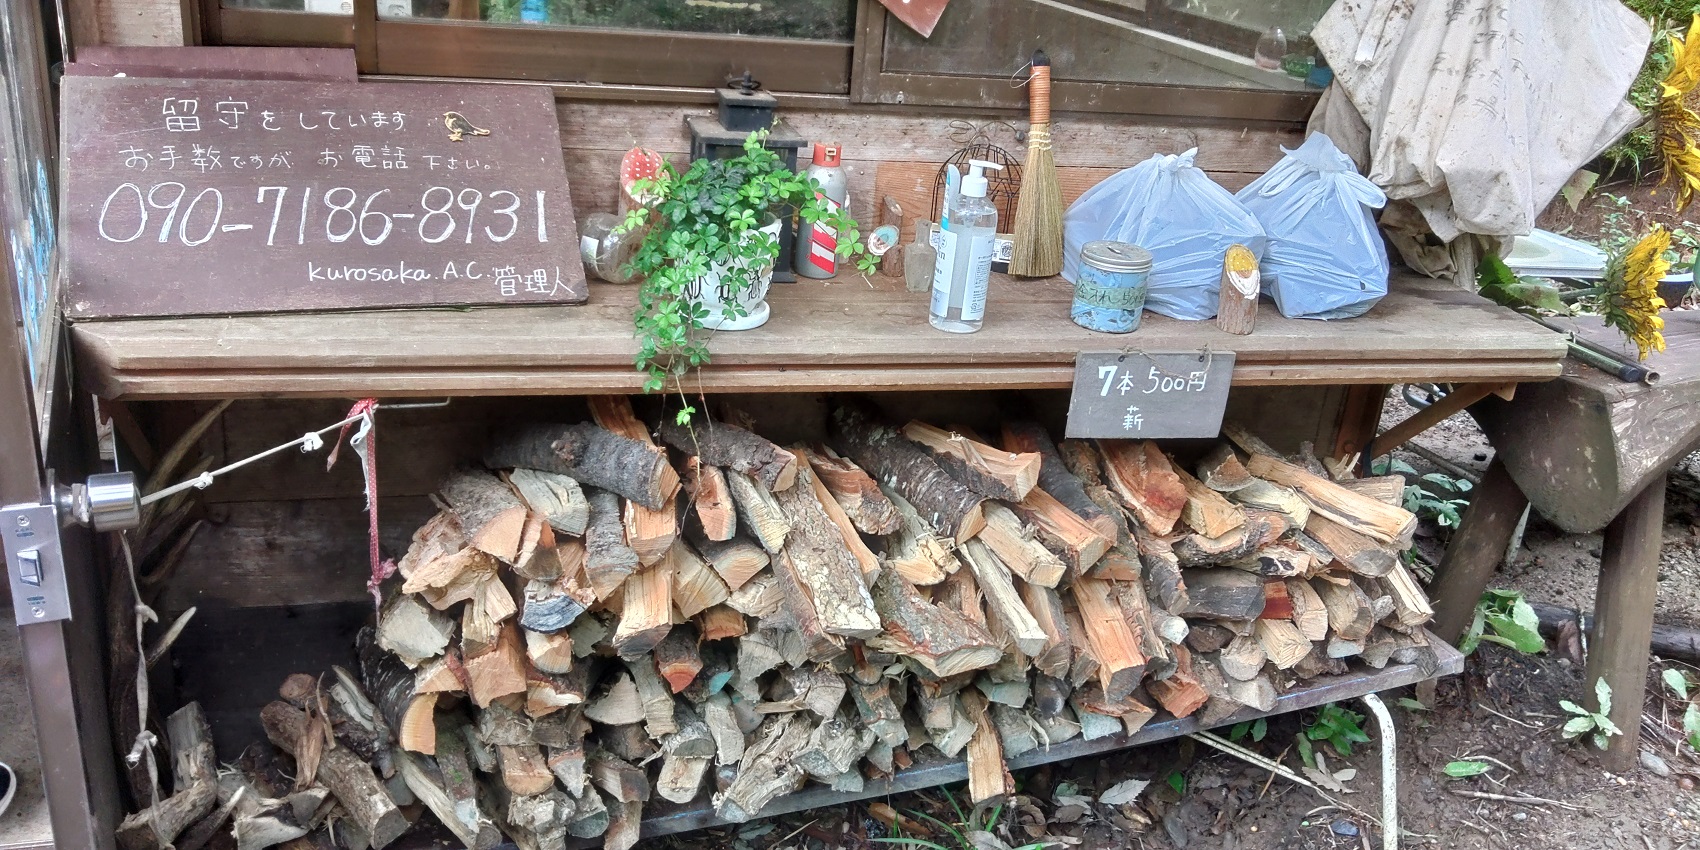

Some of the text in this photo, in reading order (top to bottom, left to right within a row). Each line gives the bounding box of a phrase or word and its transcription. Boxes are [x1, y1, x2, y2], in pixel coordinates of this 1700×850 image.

[99, 181, 549, 247] 090-7186-8931
[1098, 365, 1207, 397] 7本 500円
[1122, 405, 1144, 430] 薪
